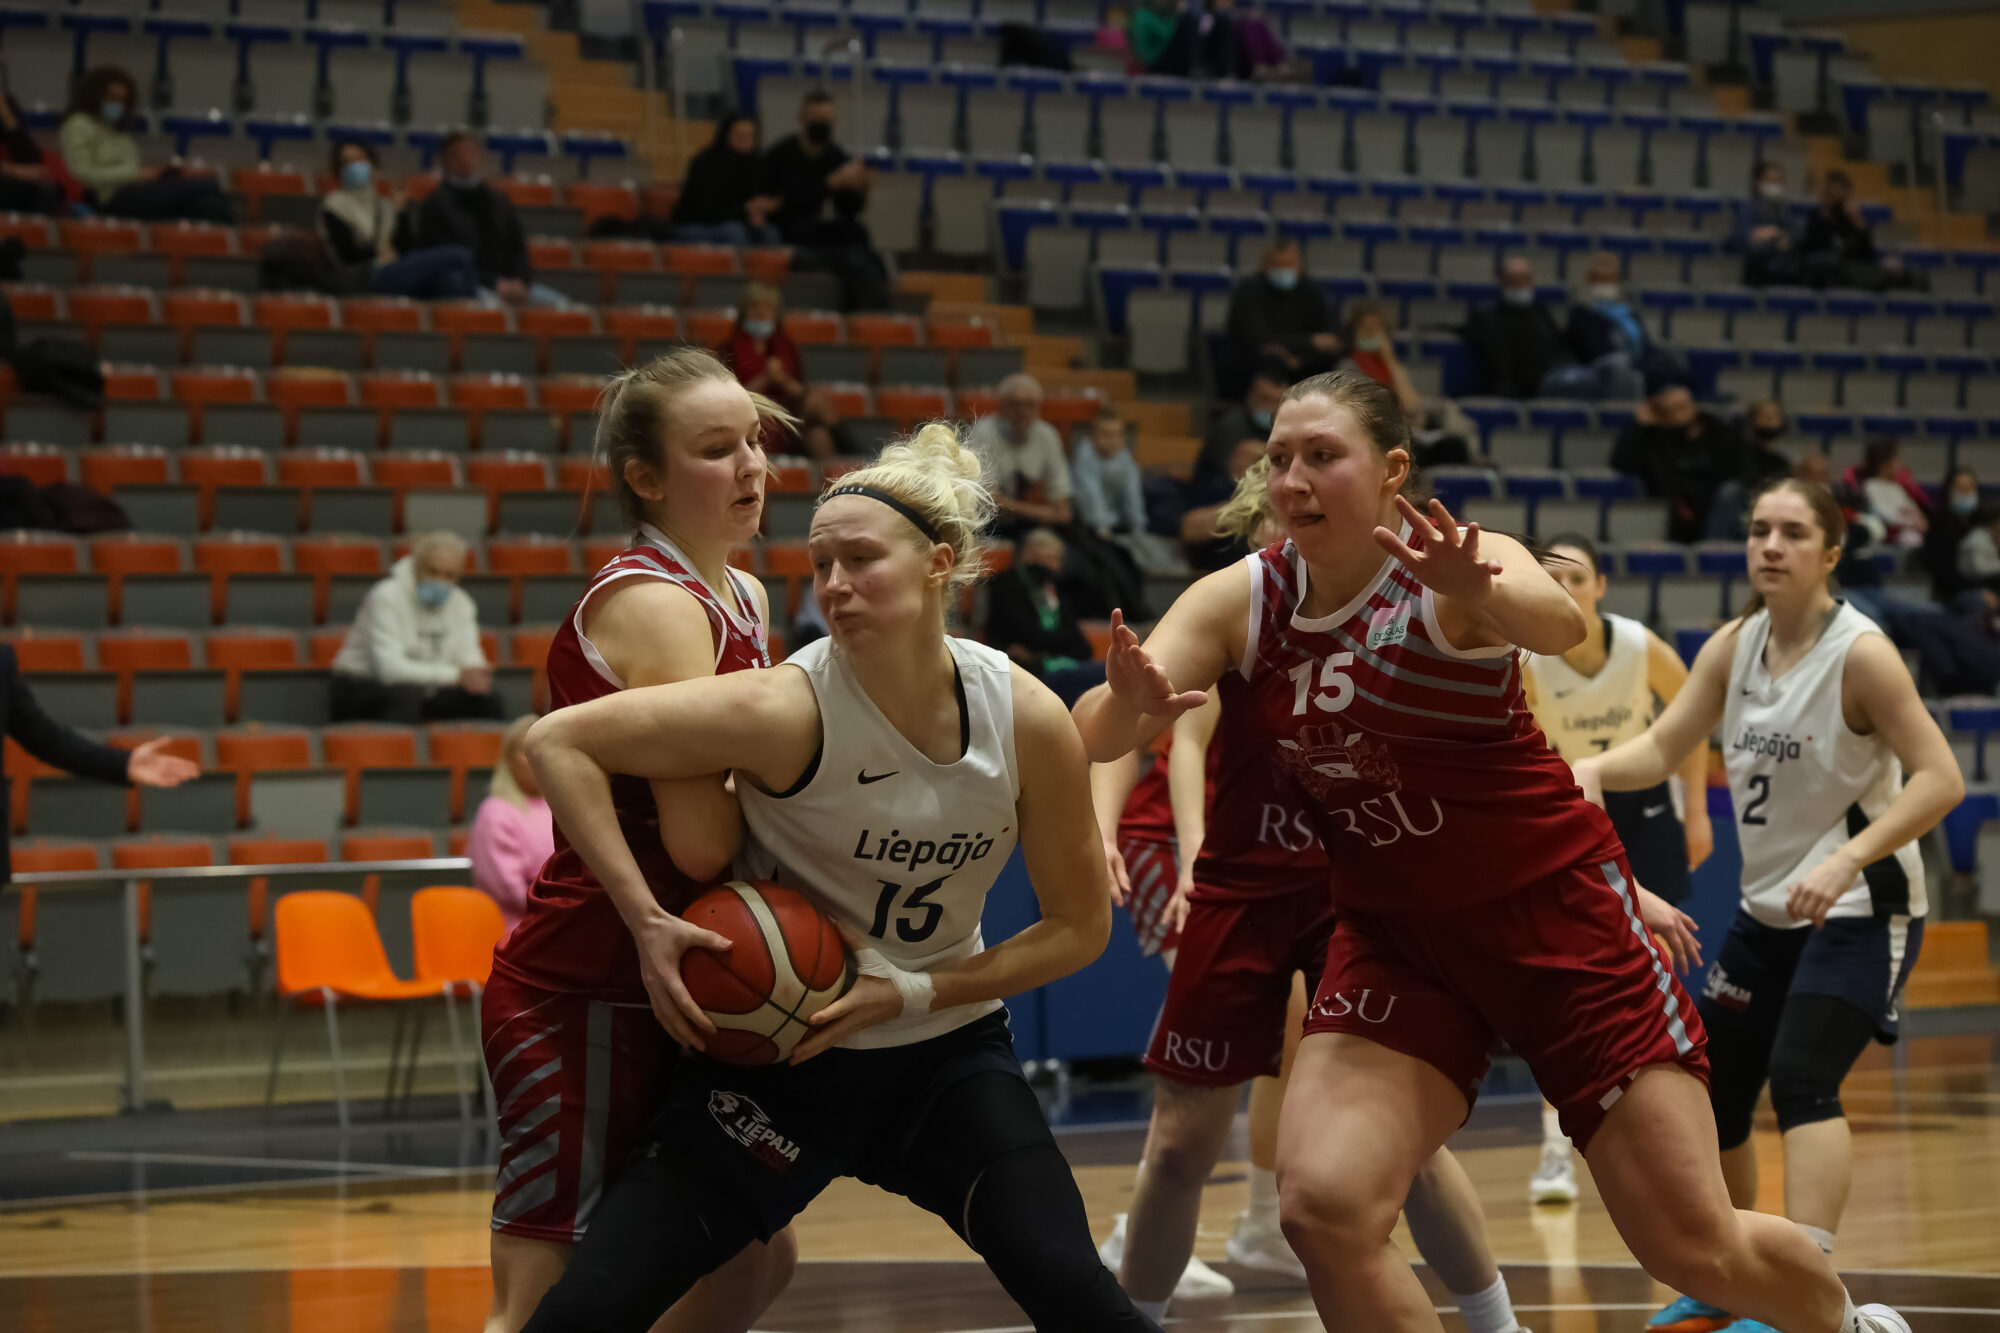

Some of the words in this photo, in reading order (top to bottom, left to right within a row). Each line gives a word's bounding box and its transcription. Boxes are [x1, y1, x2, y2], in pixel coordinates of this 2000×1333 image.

[1288, 651, 1356, 716] 15
[1741, 774, 1773, 826] 2
[853, 829, 995, 872] Liepāja
[1257, 803, 1318, 852] RS
[868, 873, 956, 943] 15
[1164, 1030, 1230, 1072] RSU
[734, 1115, 801, 1163] LIEPAJA
